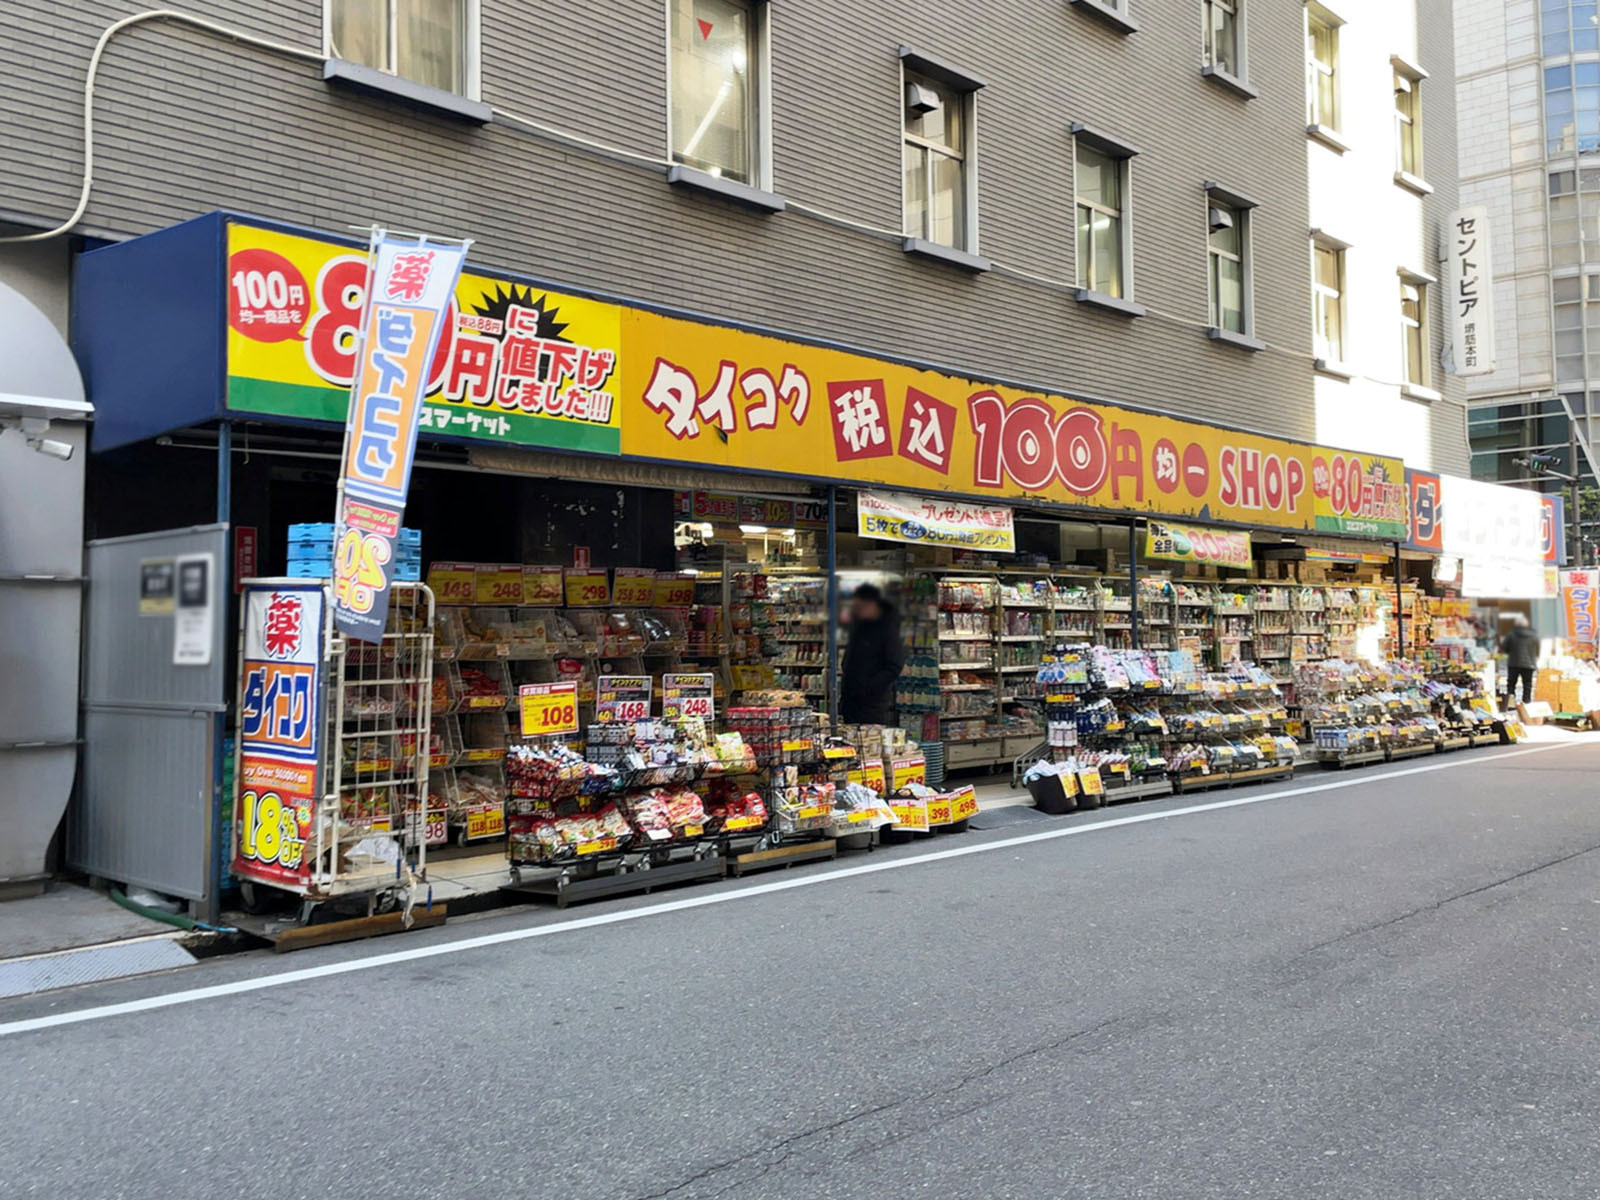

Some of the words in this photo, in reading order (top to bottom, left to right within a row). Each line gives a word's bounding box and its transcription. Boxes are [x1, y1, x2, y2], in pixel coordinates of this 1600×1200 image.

[1457, 218, 1479, 317] セントピア
[232, 270, 305, 309] 100円
[500, 334, 614, 388] 値下げ
[643, 357, 812, 440] ダイコク
[1218, 446, 1306, 513] SHOP
[442, 581, 472, 598] 148
[492, 582, 522, 598] 248
[582, 585, 607, 600] 298
[265, 592, 302, 655] 薬
[243, 670, 311, 742] ダイコク
[620, 702, 644, 719] 168
[685, 699, 708, 715] 248
[541, 705, 574, 727] 108
[931, 808, 949, 820] 398
[960, 799, 976, 813] 498
